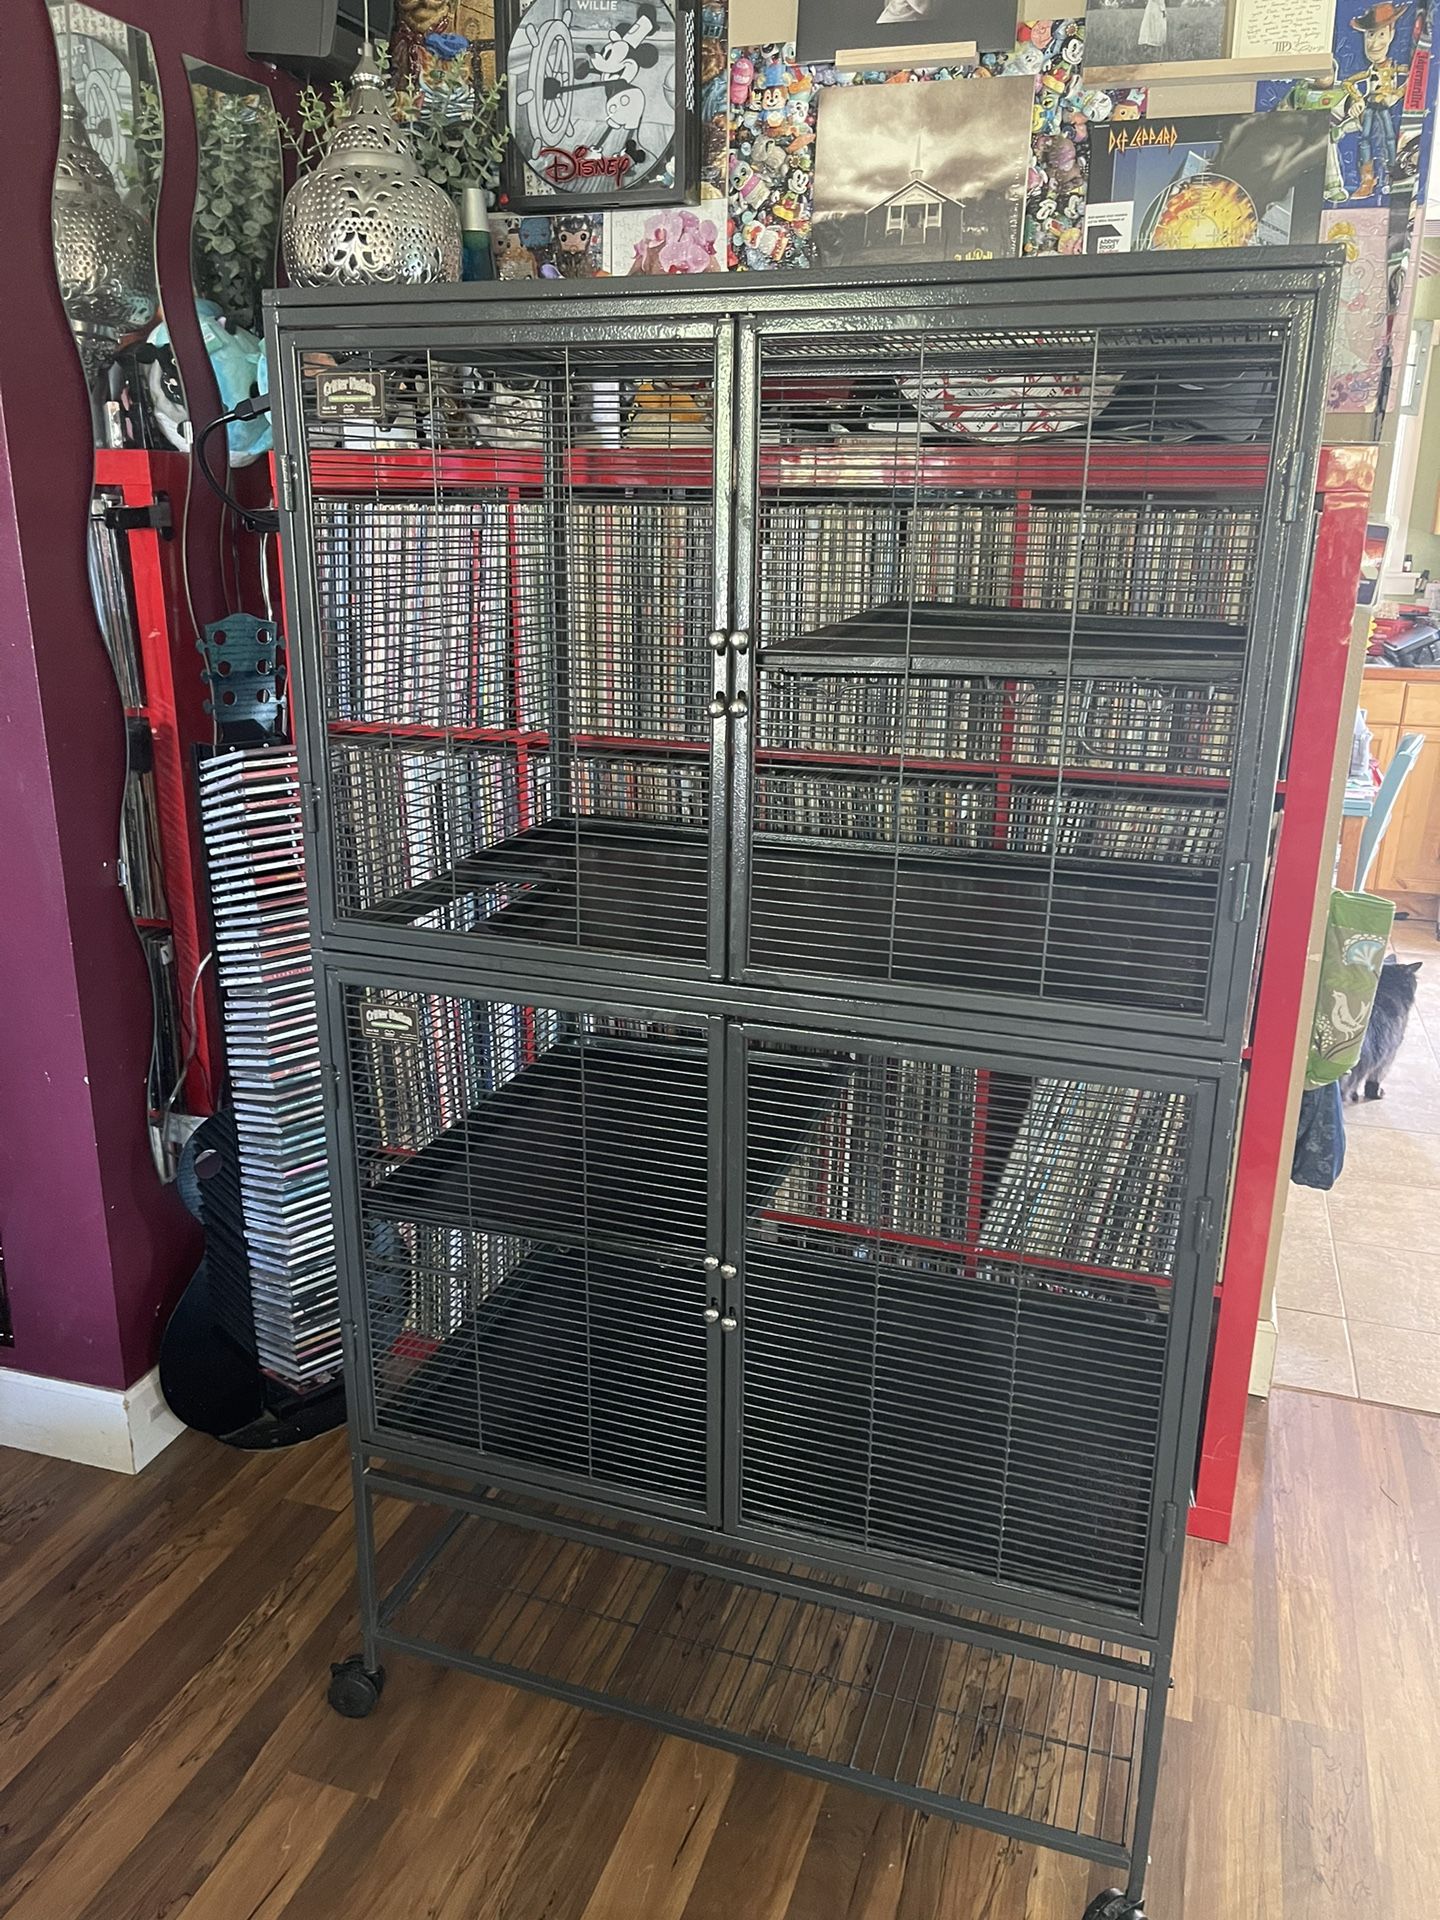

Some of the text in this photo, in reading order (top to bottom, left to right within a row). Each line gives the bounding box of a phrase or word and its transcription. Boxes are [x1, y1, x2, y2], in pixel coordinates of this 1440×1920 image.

[577, 0, 618, 11] WILLIE
[1108, 124, 1178, 155] DEF LEPPARD
